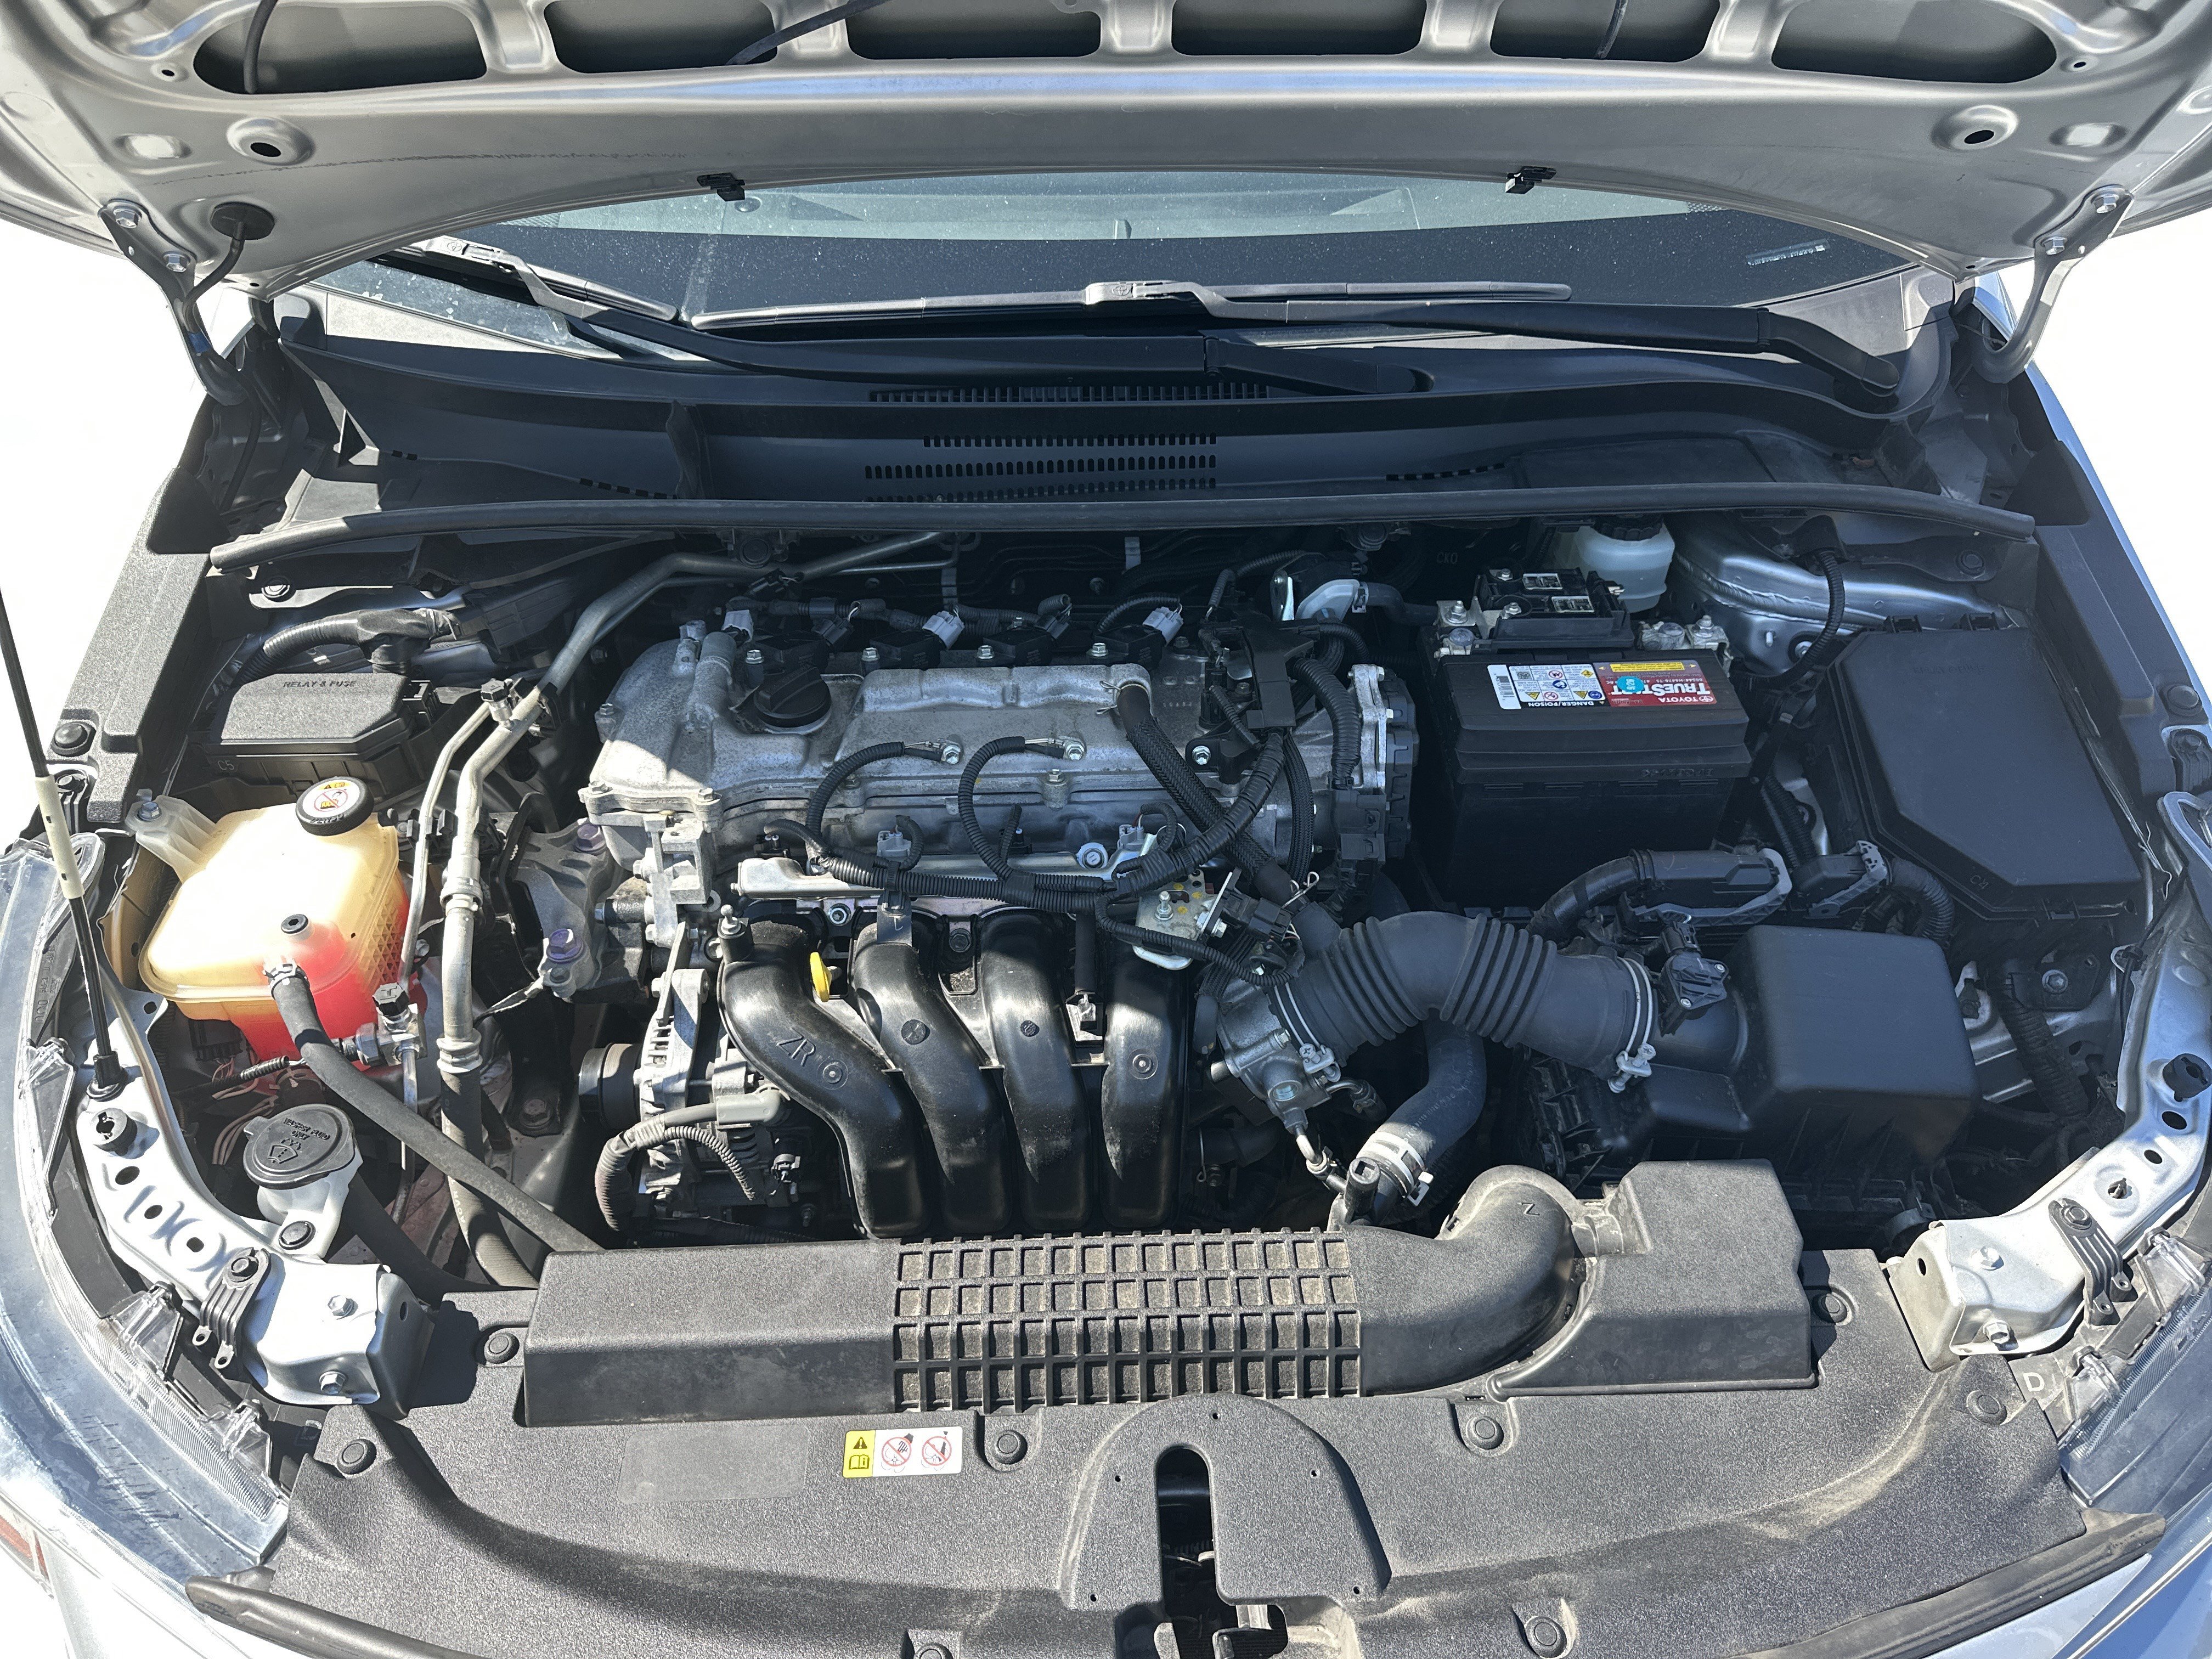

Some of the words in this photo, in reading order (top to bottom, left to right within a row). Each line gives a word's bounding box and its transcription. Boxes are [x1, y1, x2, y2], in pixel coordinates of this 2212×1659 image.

[776, 1027, 816, 1067] ZR
[291, 1130, 311, 1141] ONLY
[310, 1129, 331, 1141] FLUID
[2022, 1372, 2045, 1392] D
